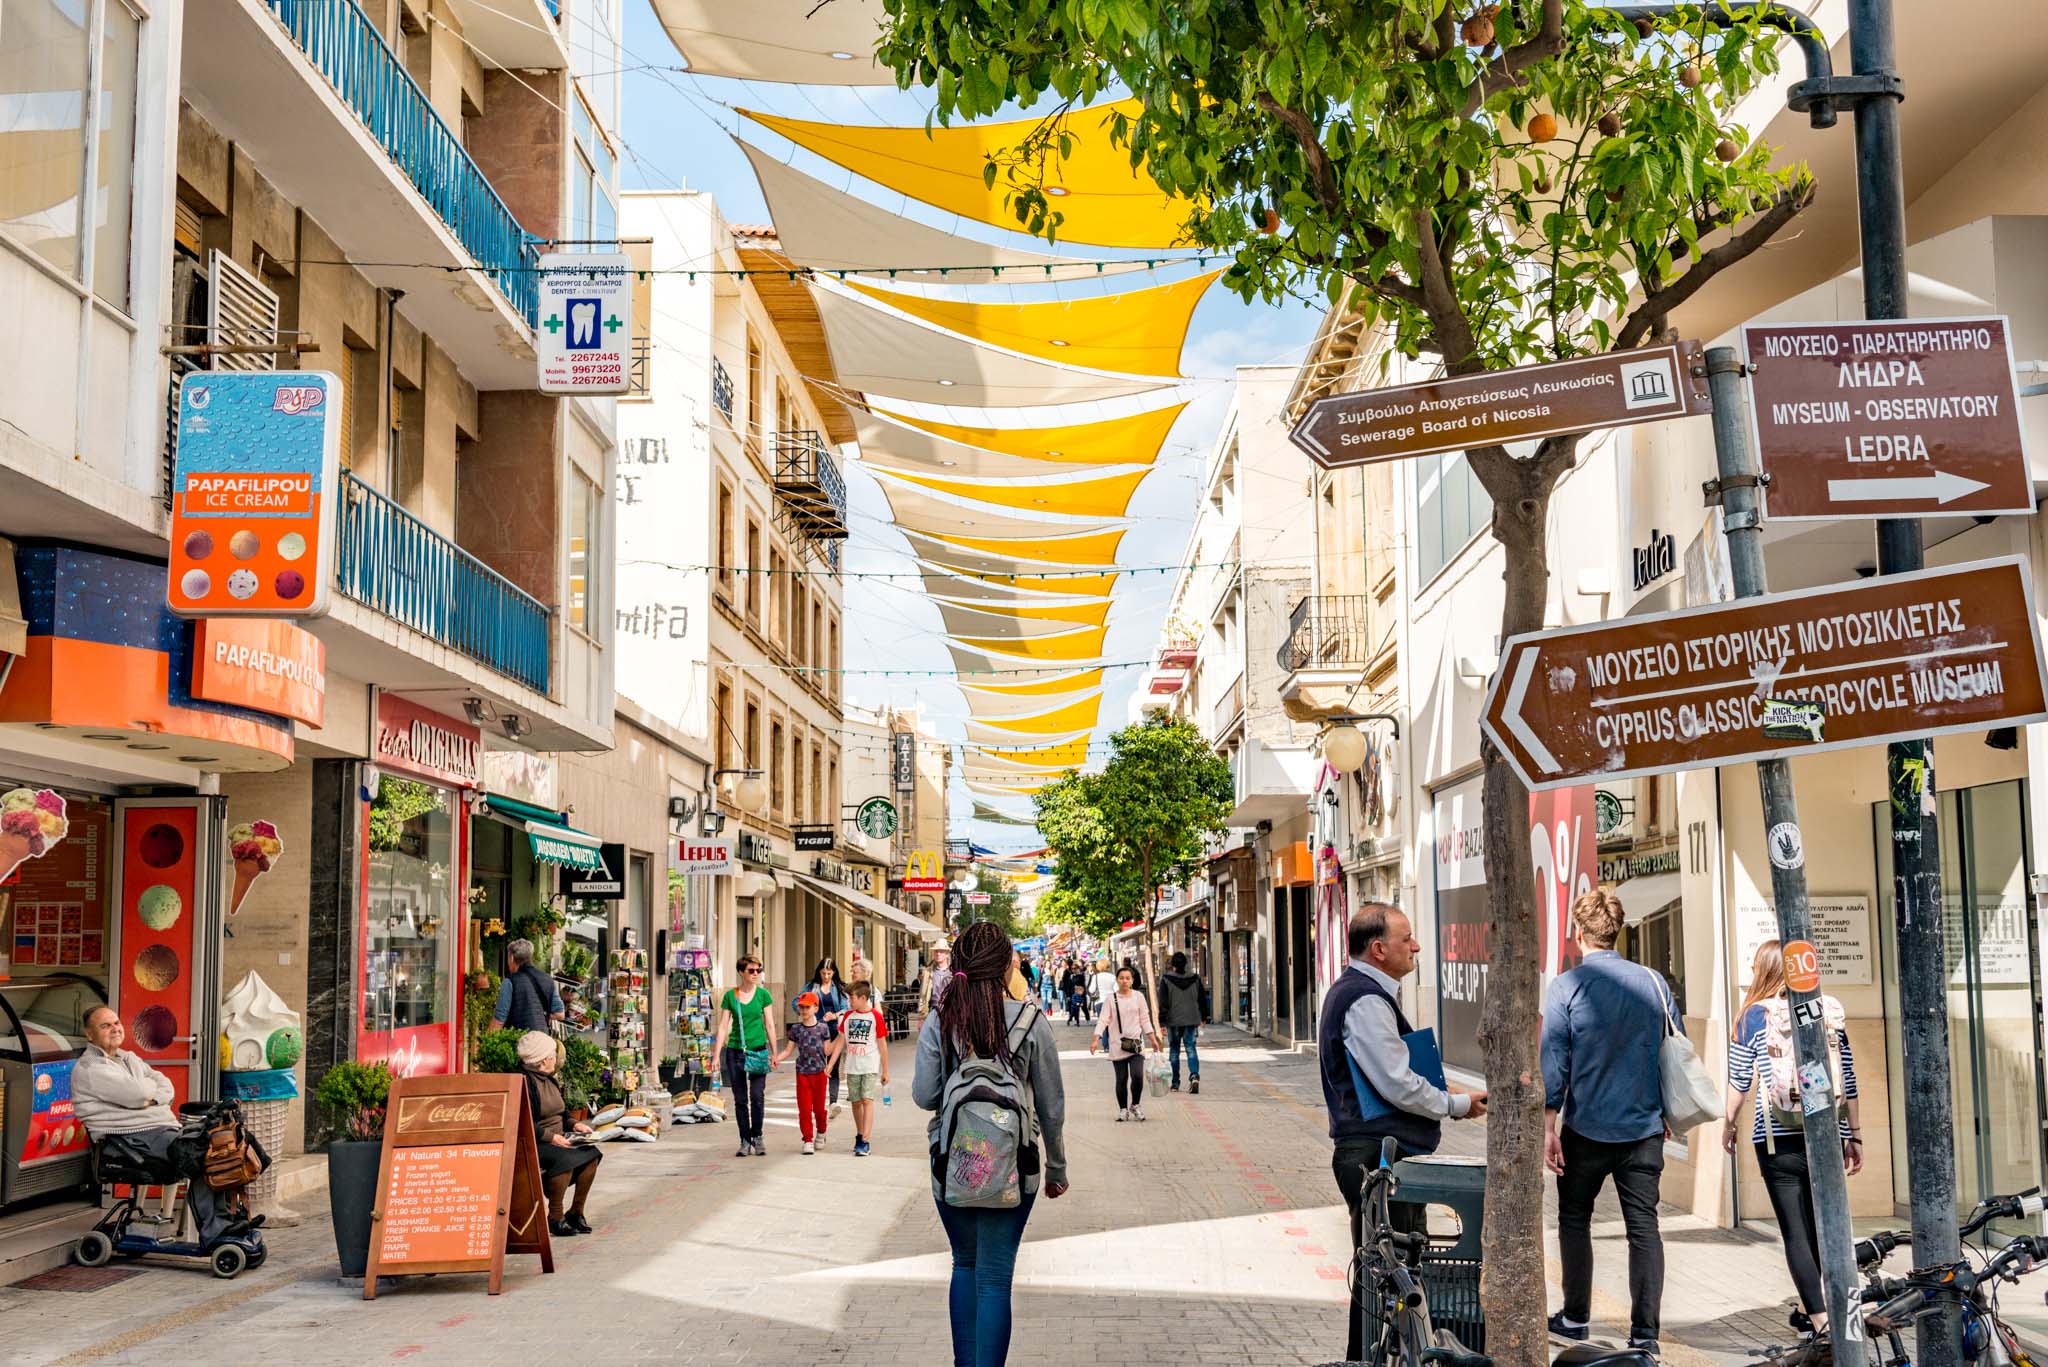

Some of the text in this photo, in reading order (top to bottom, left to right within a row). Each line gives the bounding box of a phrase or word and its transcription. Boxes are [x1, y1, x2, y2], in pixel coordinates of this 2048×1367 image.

[1765, 334, 1839, 357] ΜΟΥΣΕΙΟ
[1852, 328, 1991, 355] ΠΑΡΑΤΗΡΗΤΗΡΙΟ
[571, 353, 620, 362] 22672445
[571, 364, 621, 374] 99673220
[1838, 360, 1925, 388] ΛΗΔΡΑ
[571, 376, 621, 385] 22672045
[1337, 372, 1615, 425] Συμβούλιο Αποχετεύσεως Λευκωσίας
[1772, 402, 1851, 425] MYSEUM
[1865, 395, 1999, 422] OBSERVATORY
[1340, 403, 1551, 446] Sewerage Board of Nicosia
[1845, 434, 1930, 463] LEDRA
[206, 494, 289, 506] ICE CREAM
[1586, 599, 1966, 688] ΜΟΥΣΕΙΟ ΙΣΤΟΡΙΚΗΣ ΜΟΤΟΣΙΚΛΕΤΑΣ
[1596, 706, 1675, 748] CYPRUS
[1678, 694, 1764, 738] CLASSIC
[1910, 660, 2005, 705] MUSEUM
[1772, 707, 1792, 716] KICK
[411, 719, 480, 783] ORIGINALS
[901, 735, 910, 781] TATTOO
[797, 837, 831, 845] TIGER
[1688, 821, 1708, 874] 171
[1786, 951, 1817, 978] TOP 10
[1441, 963, 1464, 1000] SALE
[1465, 963, 1480, 1003] UP
[394, 1148, 500, 1161] All Natural 34 Flavours
[431, 1171, 451, 1179] yogurt
[390, 1197, 418, 1206] PRICES
[449, 1215, 467, 1223] From
[384, 1235, 404, 1243] COKE
[385, 1227, 409, 1235] FRESH
[411, 1225, 440, 1233] ORANGE
[444, 1224, 464, 1232] JUICE
[382, 1251, 407, 1259] WATER
